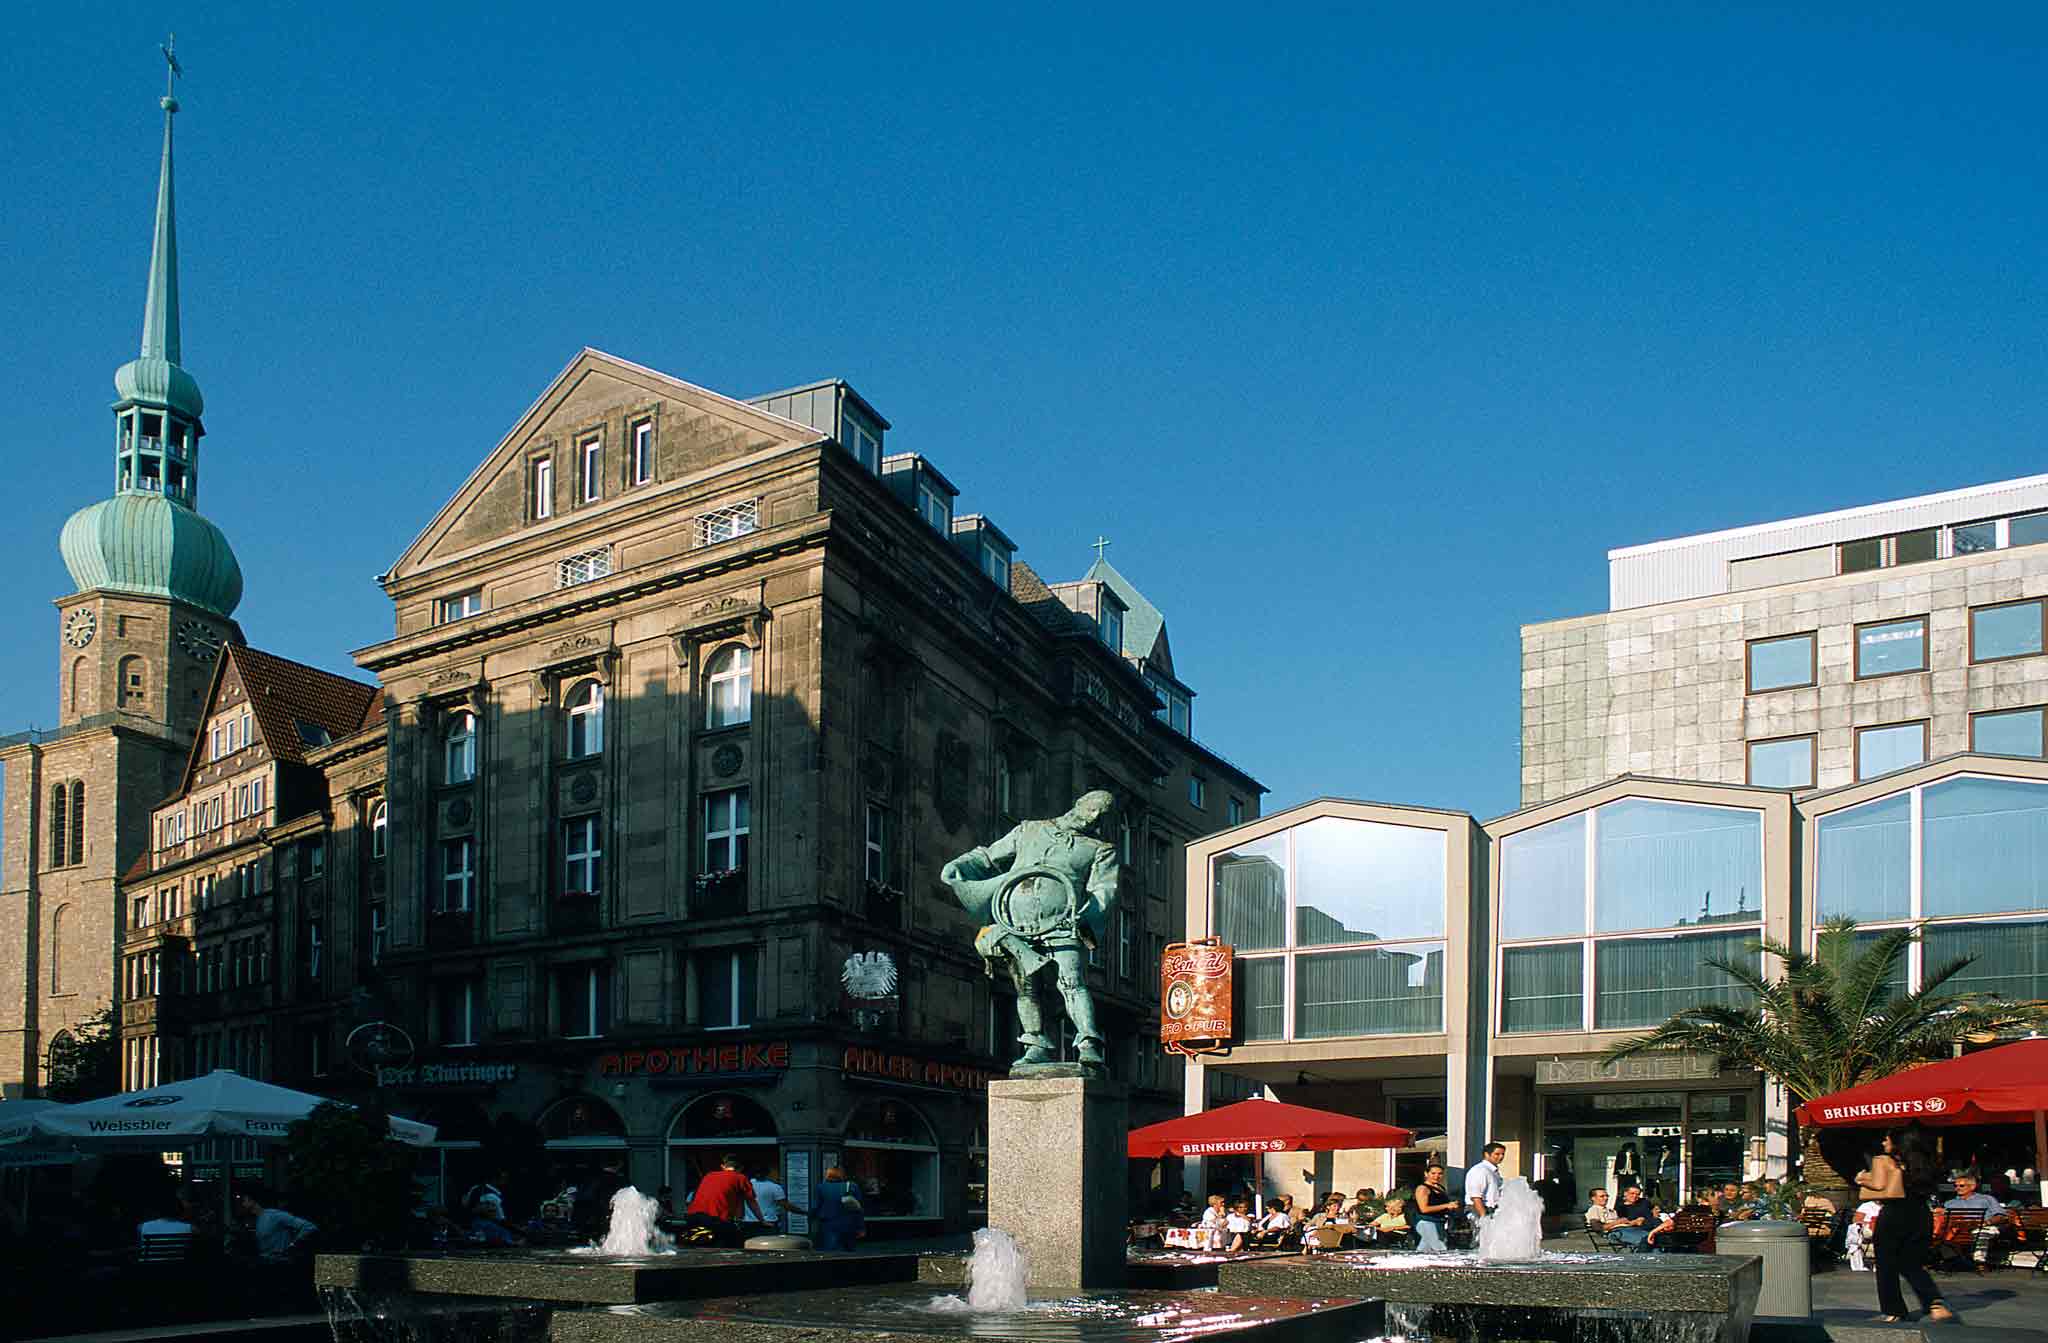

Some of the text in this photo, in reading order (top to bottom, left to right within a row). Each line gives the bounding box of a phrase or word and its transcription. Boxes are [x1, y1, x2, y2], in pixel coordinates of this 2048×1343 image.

[1193, 1020, 1226, 1032] PUB
[600, 1041, 786, 1073] APOTHEKE
[841, 1047, 912, 1081] ADLER
[1824, 1100, 1924, 1120] BRINKHOFF'S
[89, 1119, 172, 1132] Weissbier
[1182, 1141, 1268, 1153] BRINKHOFF'S
